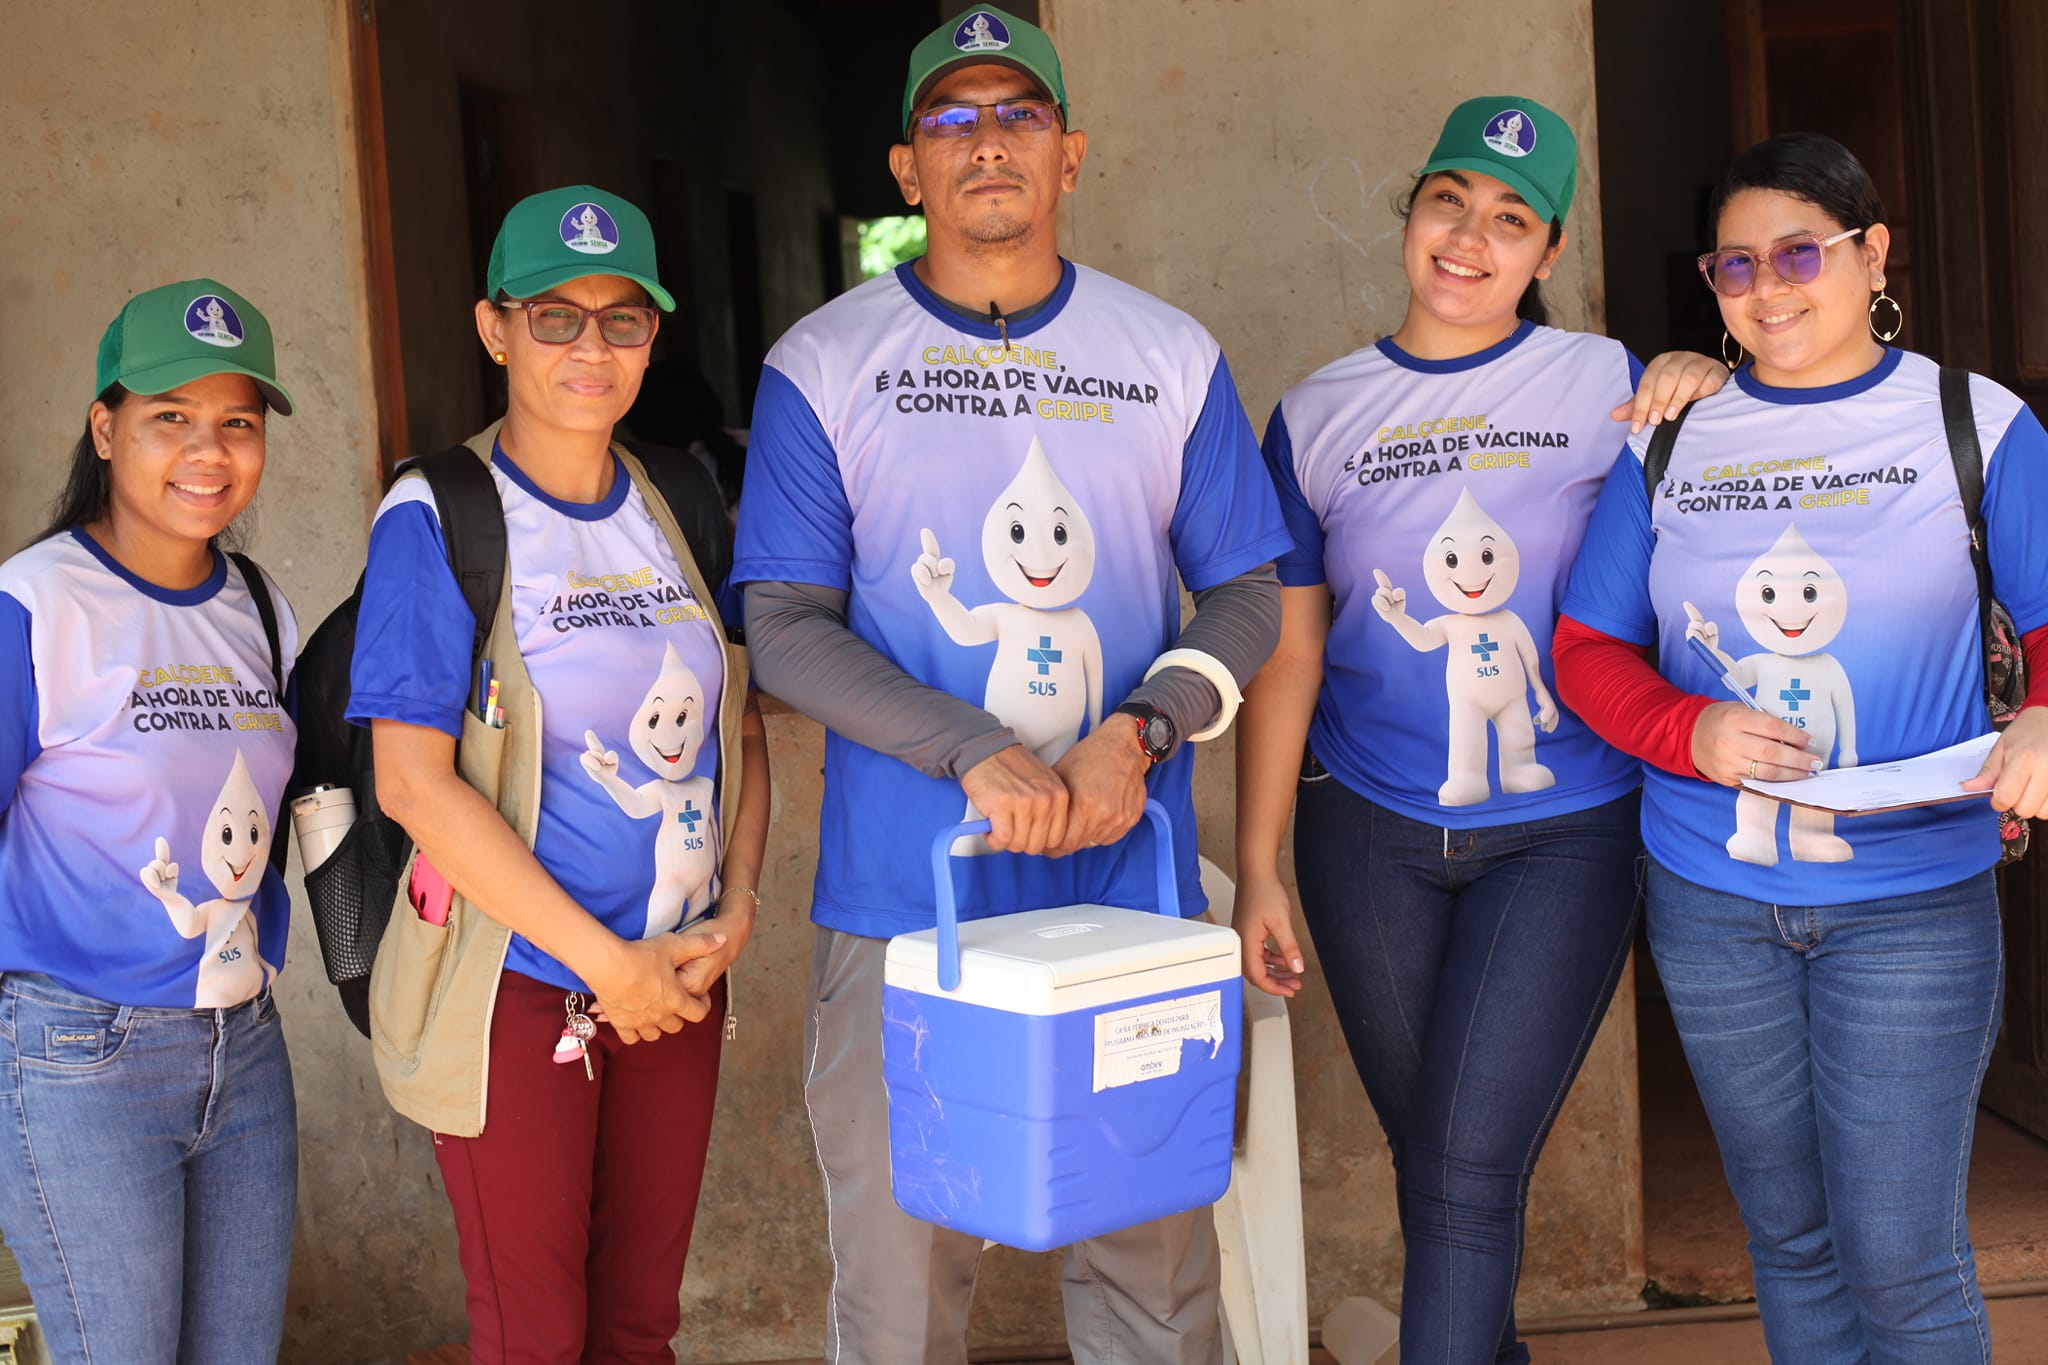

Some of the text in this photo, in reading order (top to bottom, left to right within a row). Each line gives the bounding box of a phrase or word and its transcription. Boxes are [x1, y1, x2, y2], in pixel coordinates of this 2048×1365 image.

[922, 343, 1066, 372] CALÇOENE,
[875, 367, 1159, 407] É A HORA DE VACINAR
[896, 393, 1114, 423] CONTRA A GRIPE
[1361, 451, 1373, 467] A
[1378, 438, 1438, 463] HORA
[1442, 434, 1470, 454] DE
[1474, 431, 1570, 449] VACINAR
[1358, 451, 1531, 487] CONTRA A GRIPE
[1680, 481, 1693, 496] A
[1773, 475, 1804, 492] DE
[1811, 466, 1918, 490] VACINAR
[1677, 489, 1870, 515] CONTRA A GRIPE
[550, 595, 563, 614] A
[619, 593, 650, 611] DE
[552, 611, 638, 633] CONTRA
[640, 613, 656, 627] A
[137, 663, 242, 689] CALÇOENE,
[1476, 664, 1500, 678] SUS
[131, 691, 148, 709] A
[146, 687, 203, 709] HORA
[204, 689, 230, 707] DE
[1028, 681, 1057, 697] SUS
[133, 711, 283, 733] CONTRA A GRIPE
[684, 836, 704, 851] SUS
[219, 946, 242, 964] SUS
